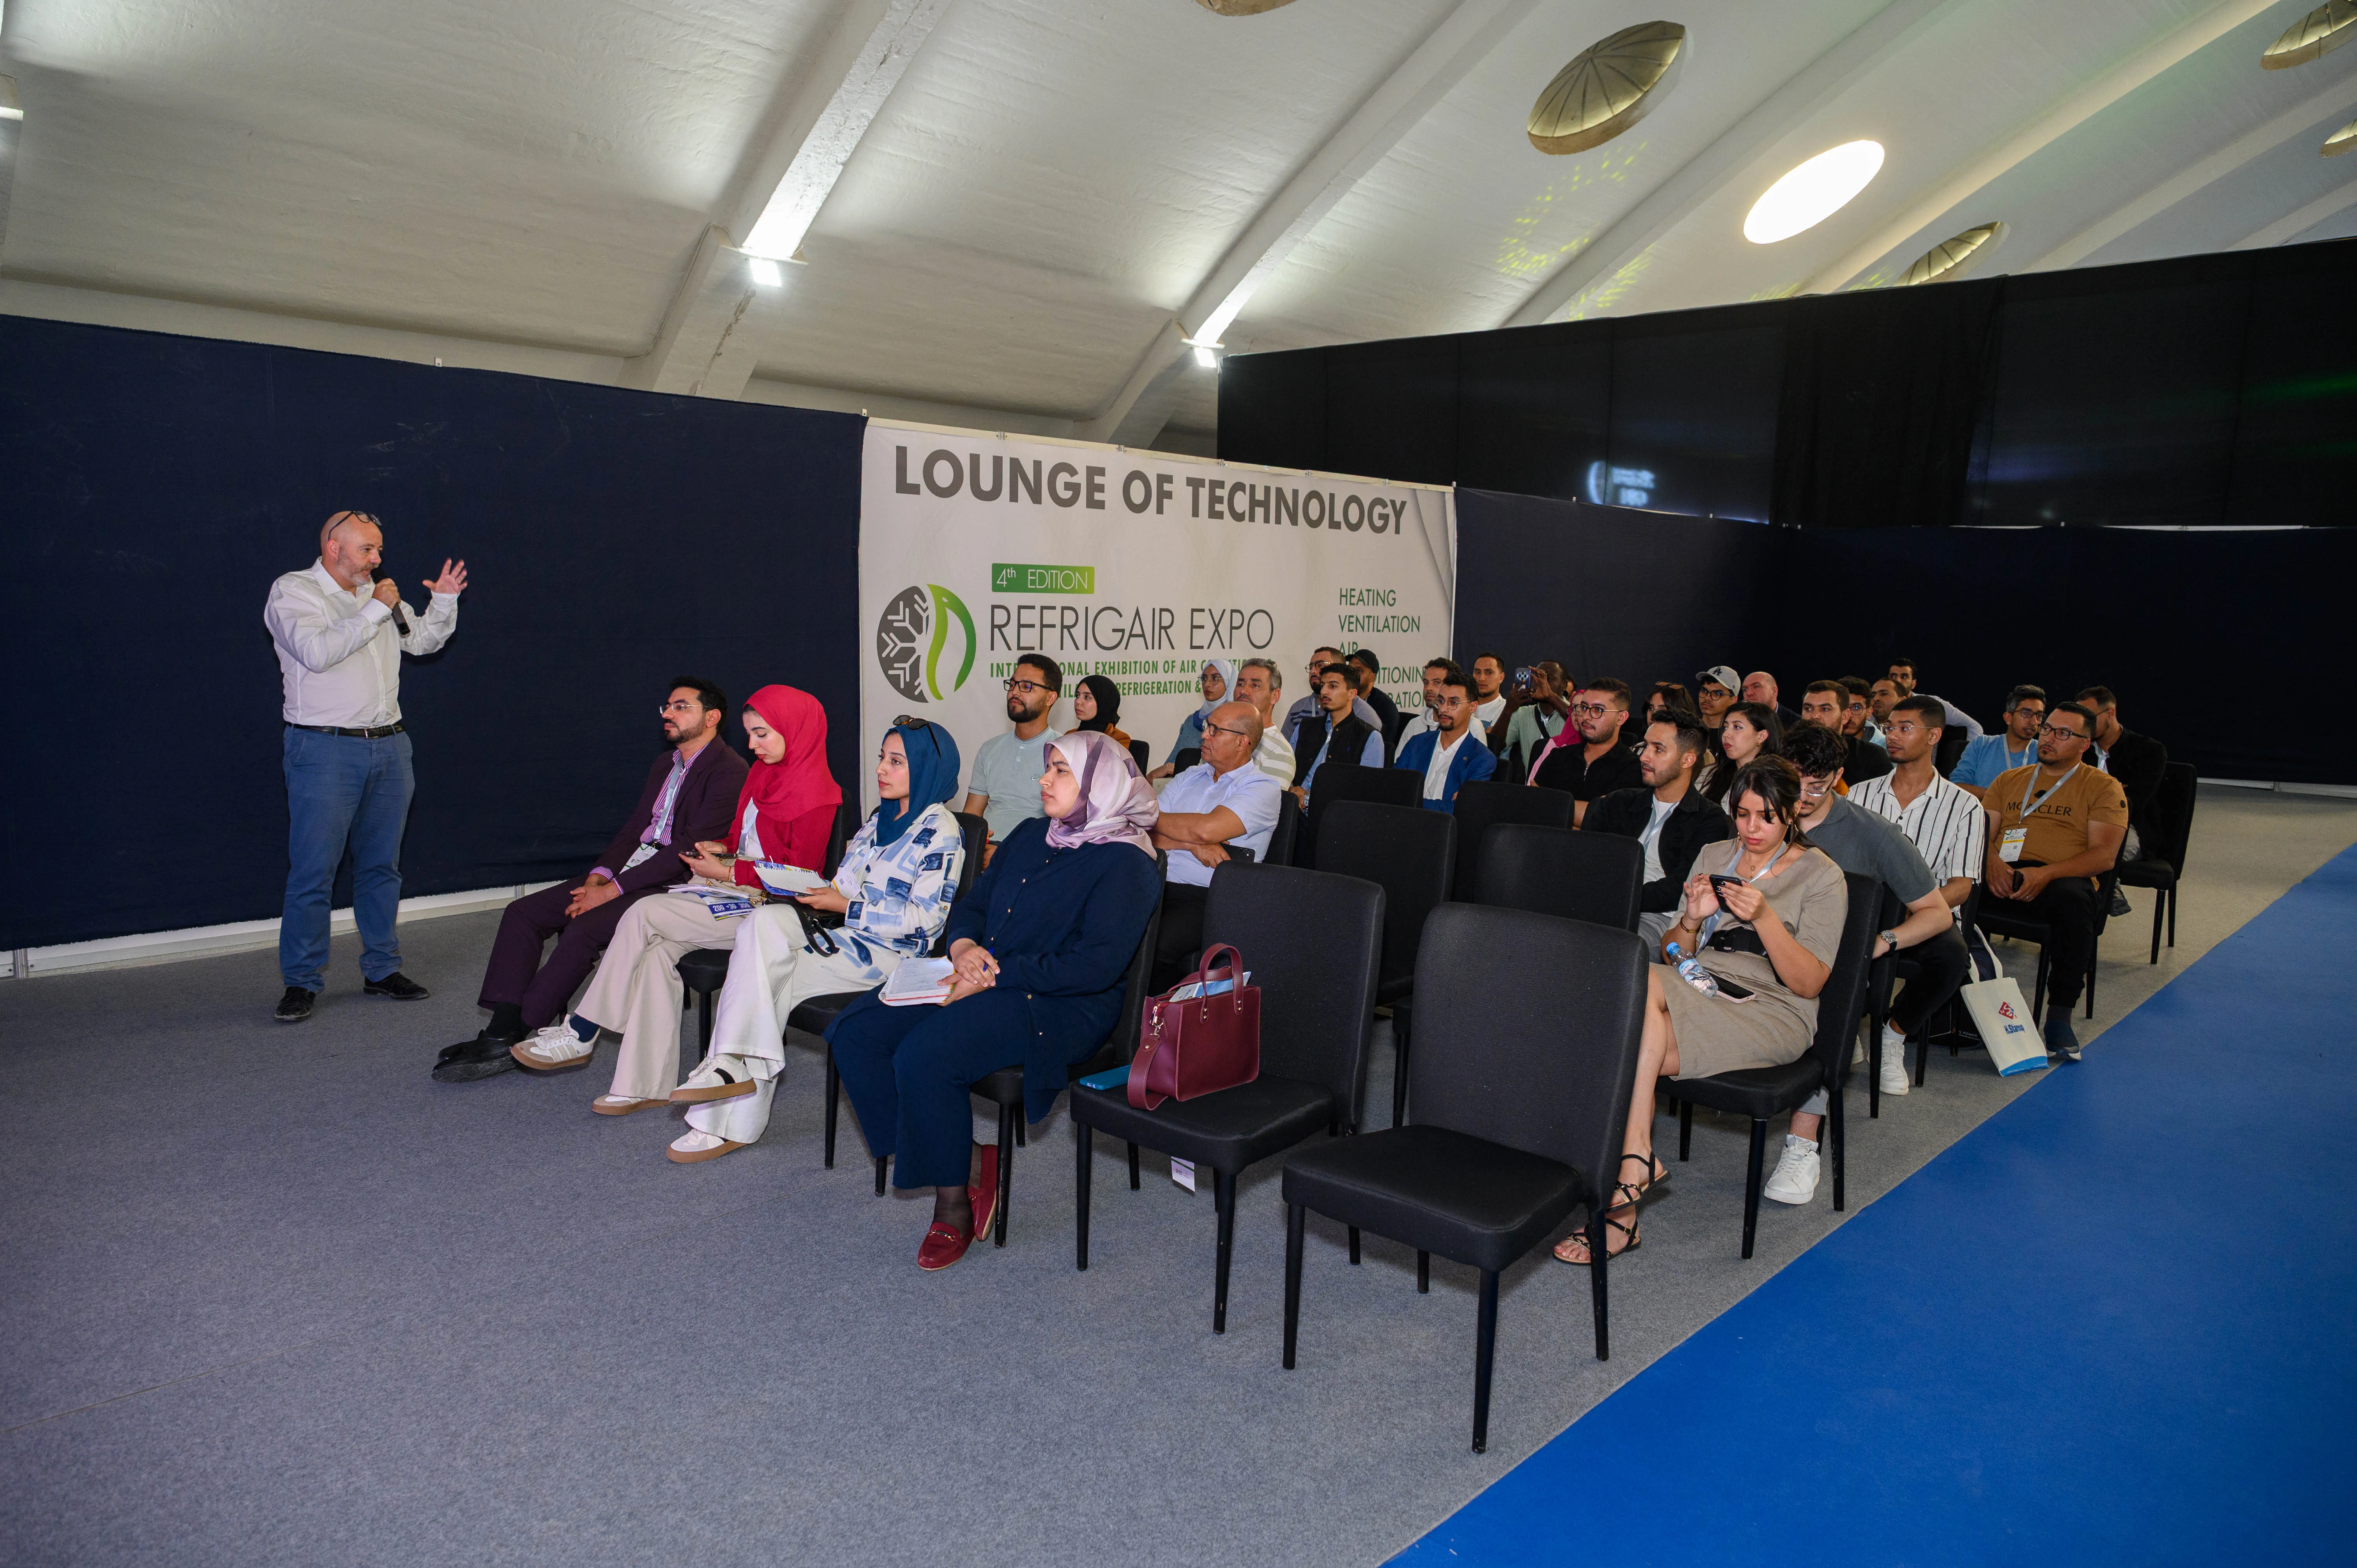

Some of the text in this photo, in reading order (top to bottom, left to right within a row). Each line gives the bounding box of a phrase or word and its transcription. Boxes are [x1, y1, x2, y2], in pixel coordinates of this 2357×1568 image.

[896, 445, 1407, 535] LOUNGE OF TECHNOLOGY
[996, 567, 1088, 590] 4th EDITION
[1339, 588, 1396, 607] HEATING
[990, 604, 1274, 651] REFRIGAIR EXPO
[1338, 614, 1421, 633] VENTILATION
[1339, 641, 1358, 656] AIR
[990, 662, 1090, 678] INTONAL
[1095, 660, 1157, 675] EXHIBITION
[1163, 660, 1175, 674] OF
[1180, 660, 1196, 673] AIR
[1116, 680, 1201, 696] REFRIGERATION &
